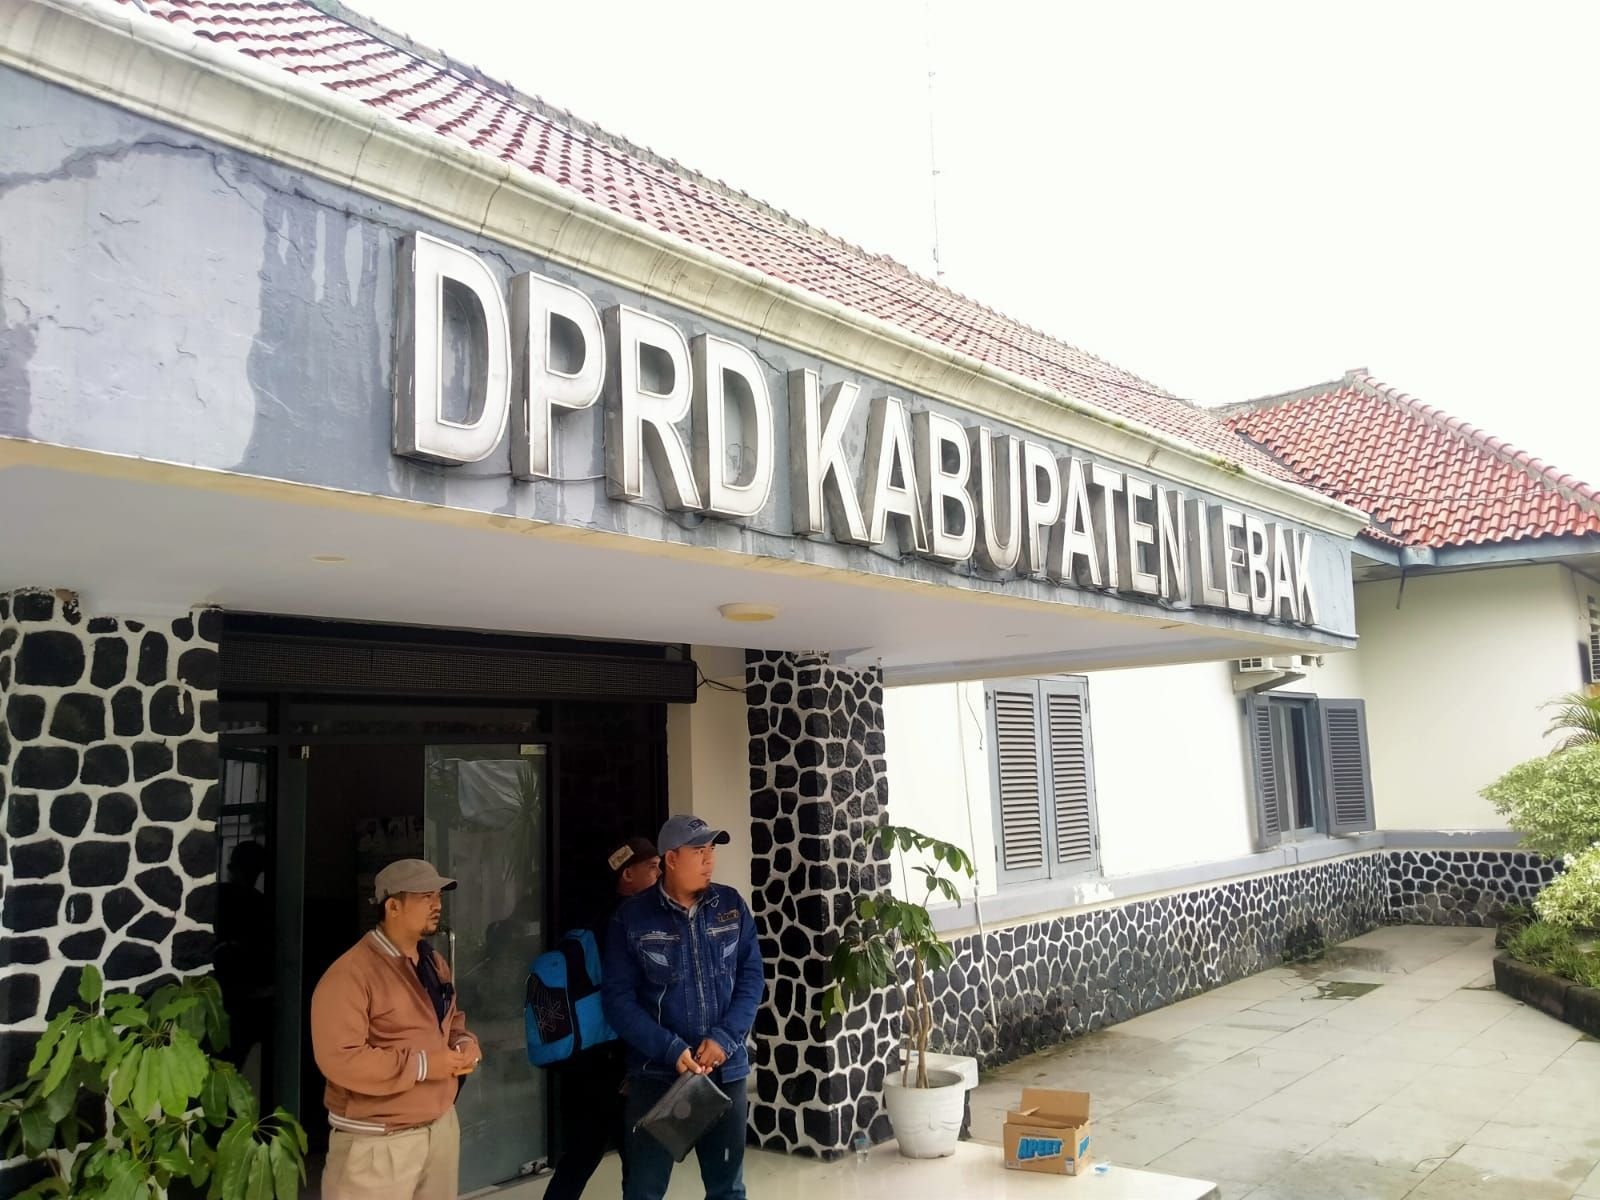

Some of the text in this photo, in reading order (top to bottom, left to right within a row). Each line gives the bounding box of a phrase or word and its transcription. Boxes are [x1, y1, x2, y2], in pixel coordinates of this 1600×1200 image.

[398, 231, 1320, 625] DPRD KABUPATEN LEBAK
